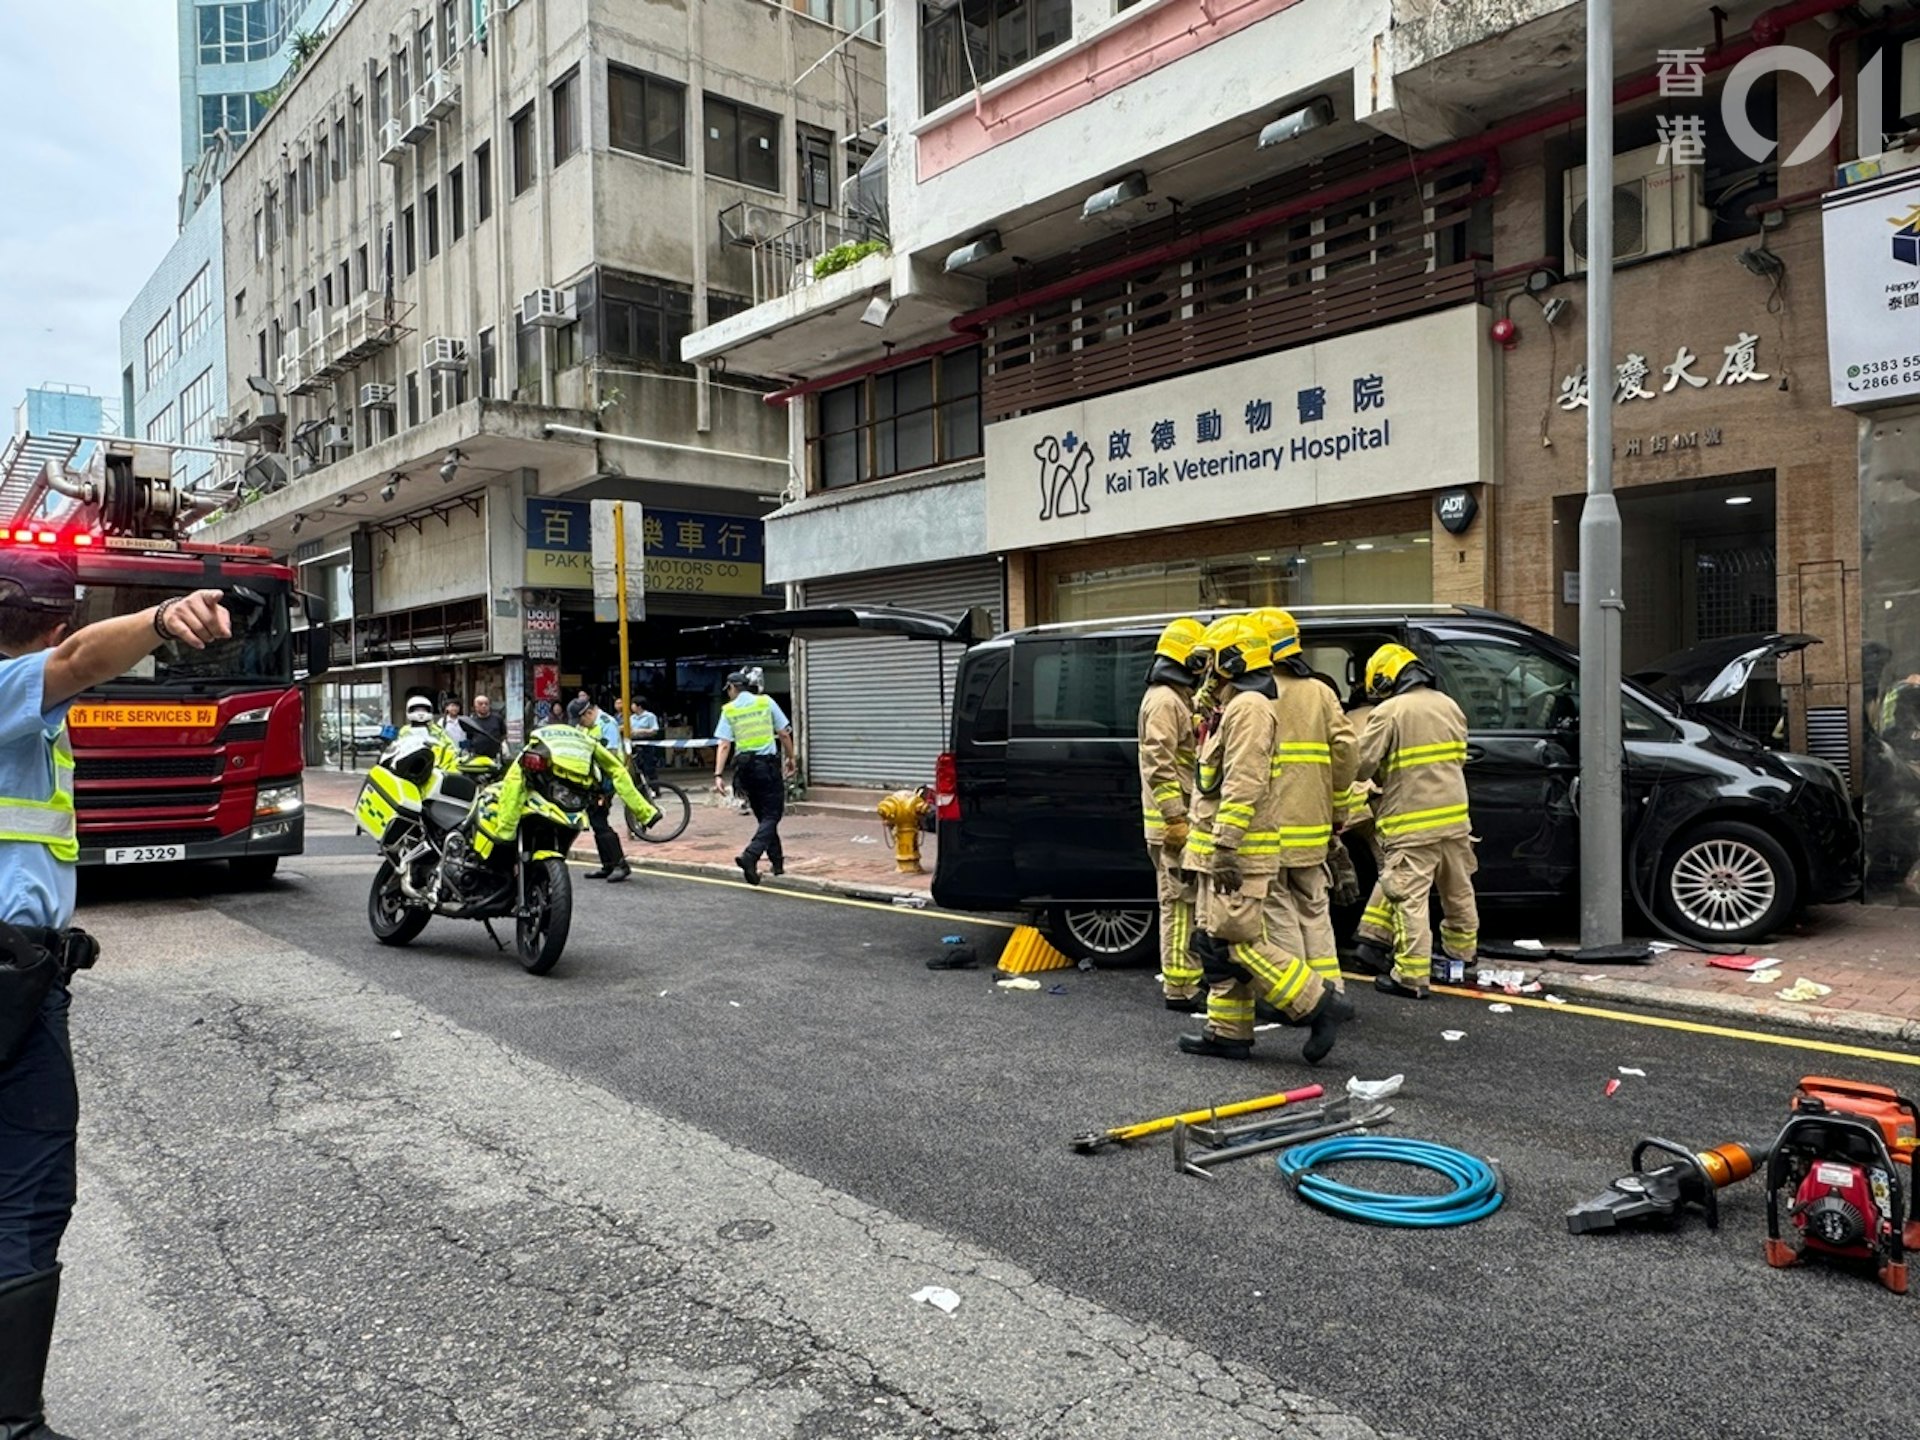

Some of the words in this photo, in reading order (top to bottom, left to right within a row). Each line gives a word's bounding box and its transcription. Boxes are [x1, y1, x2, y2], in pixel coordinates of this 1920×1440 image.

[1648, 173, 1686, 189] TOSHBA
[1862, 360, 1898, 375] 5383
[1862, 375, 1898, 390] 2866
[1105, 471, 1132, 495] Kai
[1137, 462, 1169, 488] Tak
[1173, 444, 1284, 481] Veterinary
[1291, 419, 1390, 464] Hospital
[1441, 494, 1465, 512] ADT
[541, 509, 746, 557] 百樂車行
[544, 553, 578, 568] PAK
[647, 560, 713, 576] MOTORS
[666, 575, 704, 592] 2282
[527, 609, 556, 620] LIQUI
[527, 620, 556, 630] MOLY
[73, 708, 88, 724] 消
[93, 710, 123, 723] FIRE
[127, 709, 192, 723] SERVICES
[197, 709, 211, 723] 防
[115, 851, 126, 862] F
[134, 847, 177, 861] 2329
